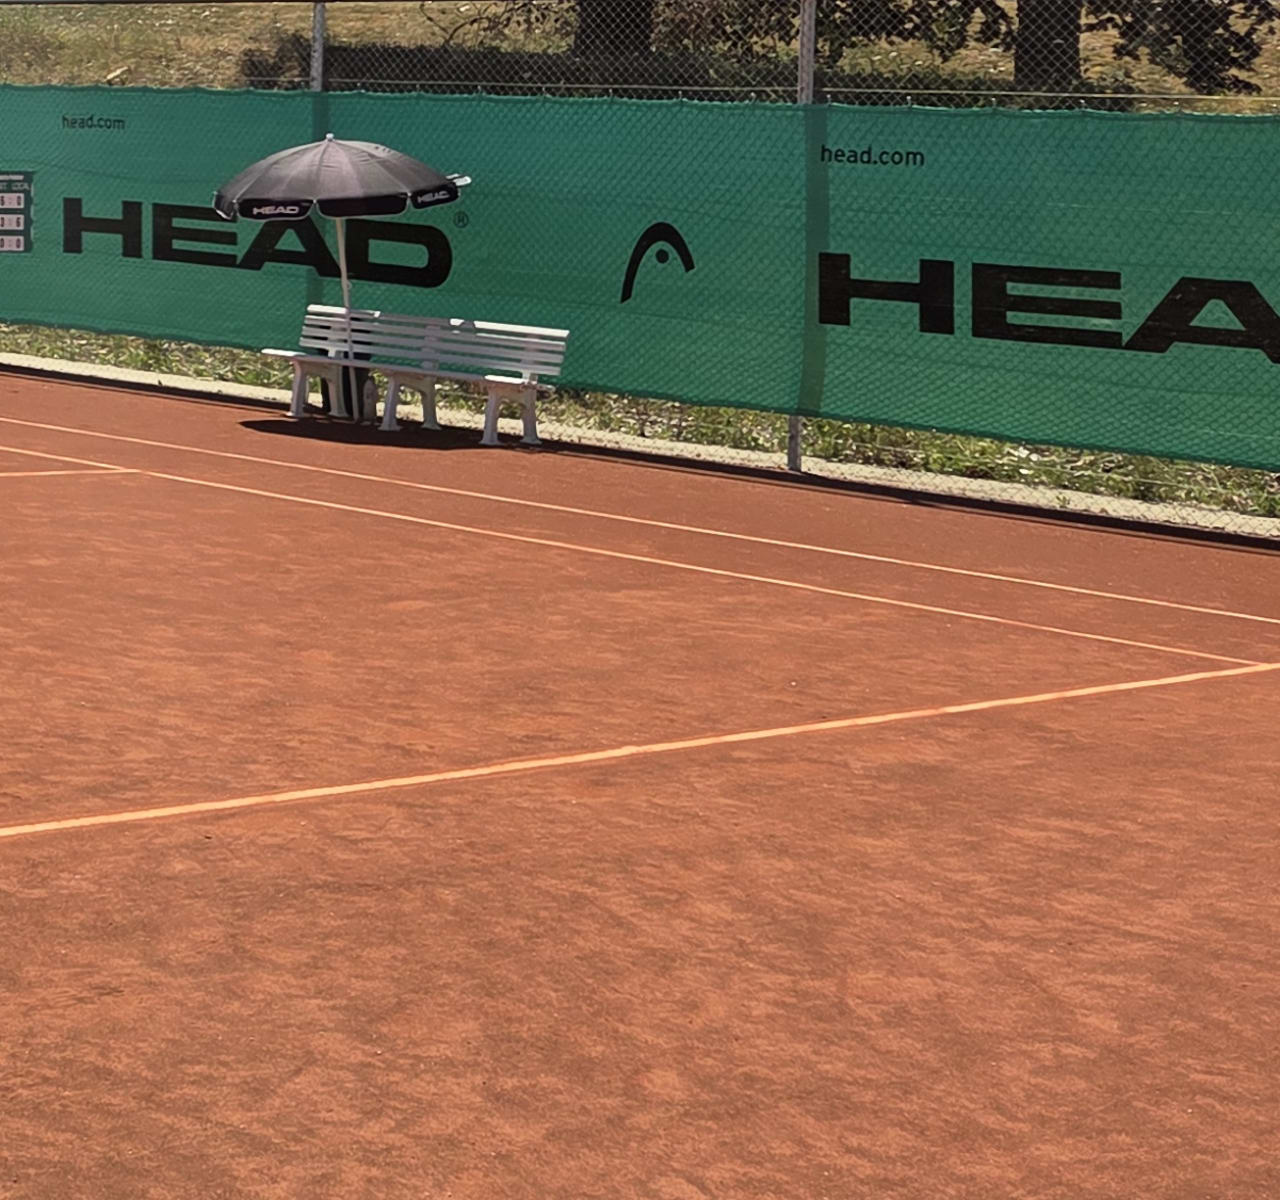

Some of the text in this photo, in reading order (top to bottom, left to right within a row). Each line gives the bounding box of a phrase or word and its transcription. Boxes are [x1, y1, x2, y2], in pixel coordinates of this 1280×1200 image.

[62, 114, 126, 130] head.com
[820, 145, 925, 167] head.com
[252, 205, 301, 215] HEAD
[62, 197, 453, 288] HEAD
